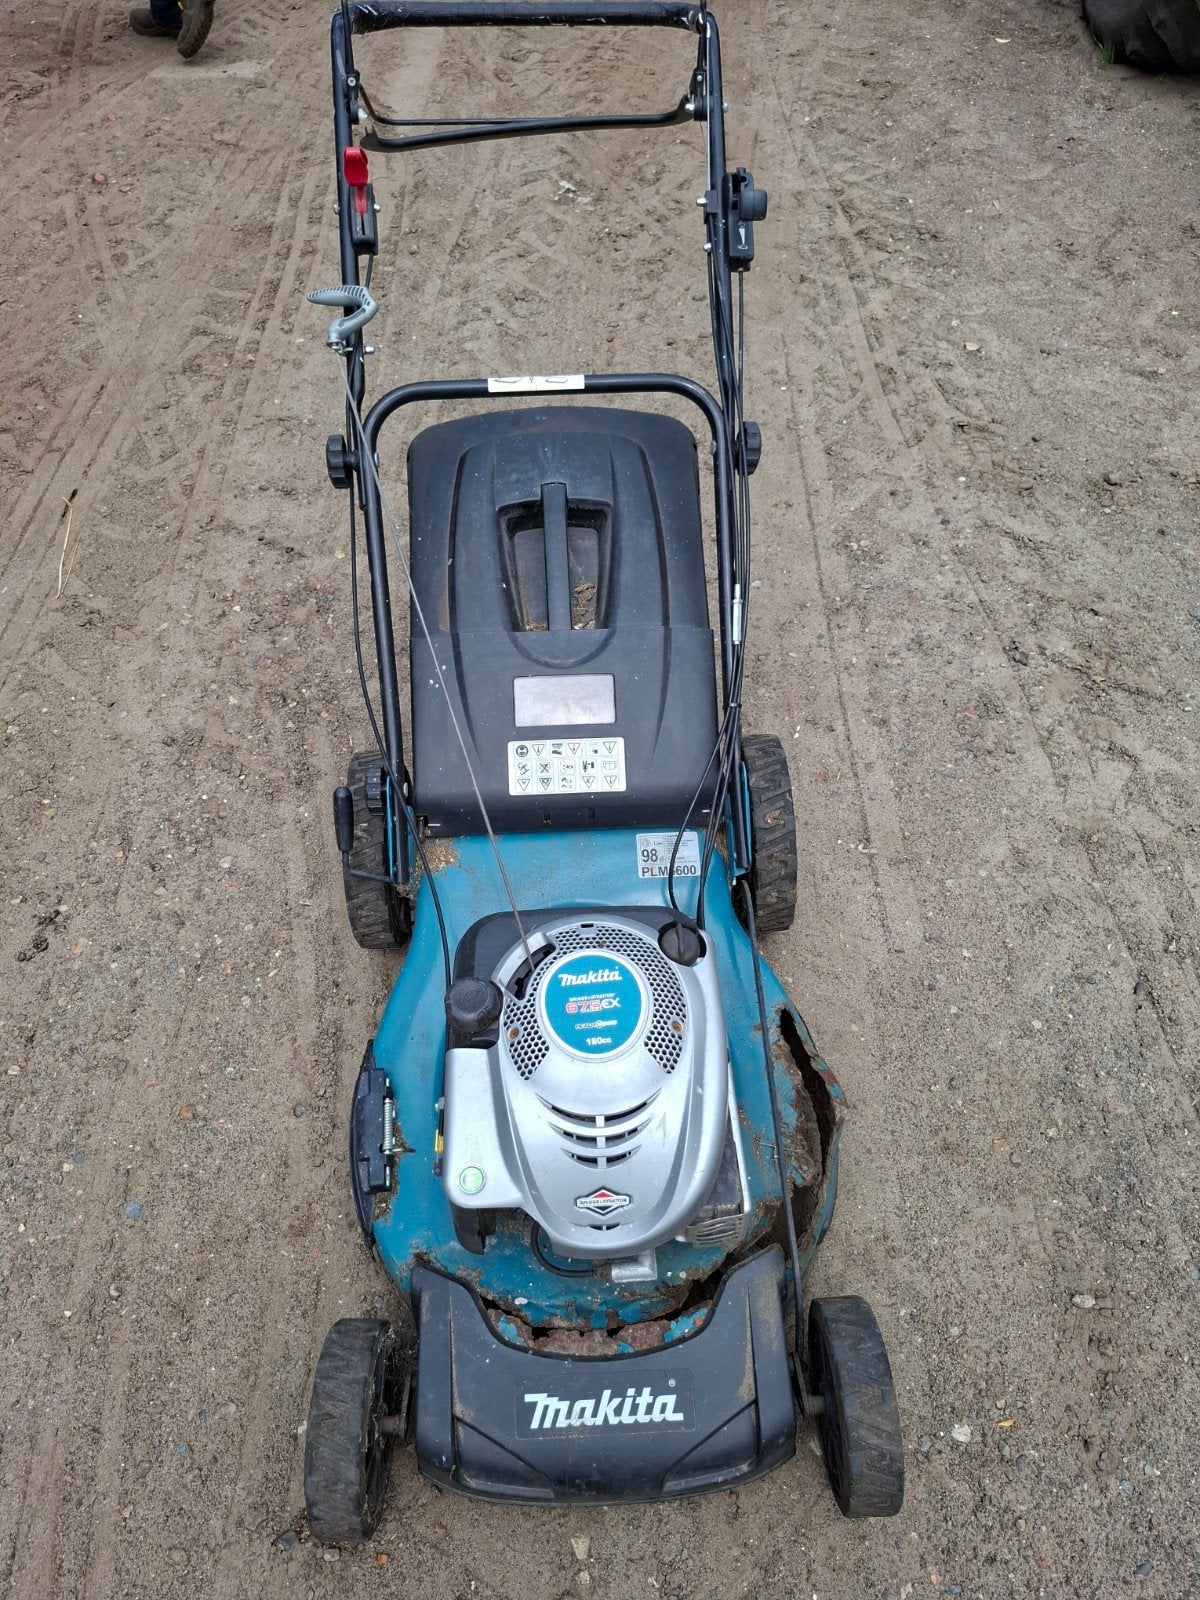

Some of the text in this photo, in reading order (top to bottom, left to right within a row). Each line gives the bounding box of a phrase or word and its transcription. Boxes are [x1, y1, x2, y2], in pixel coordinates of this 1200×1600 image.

[641, 849, 658, 862] 98
[558, 969, 622, 987] Makita
[524, 1387, 684, 1429] Makita
